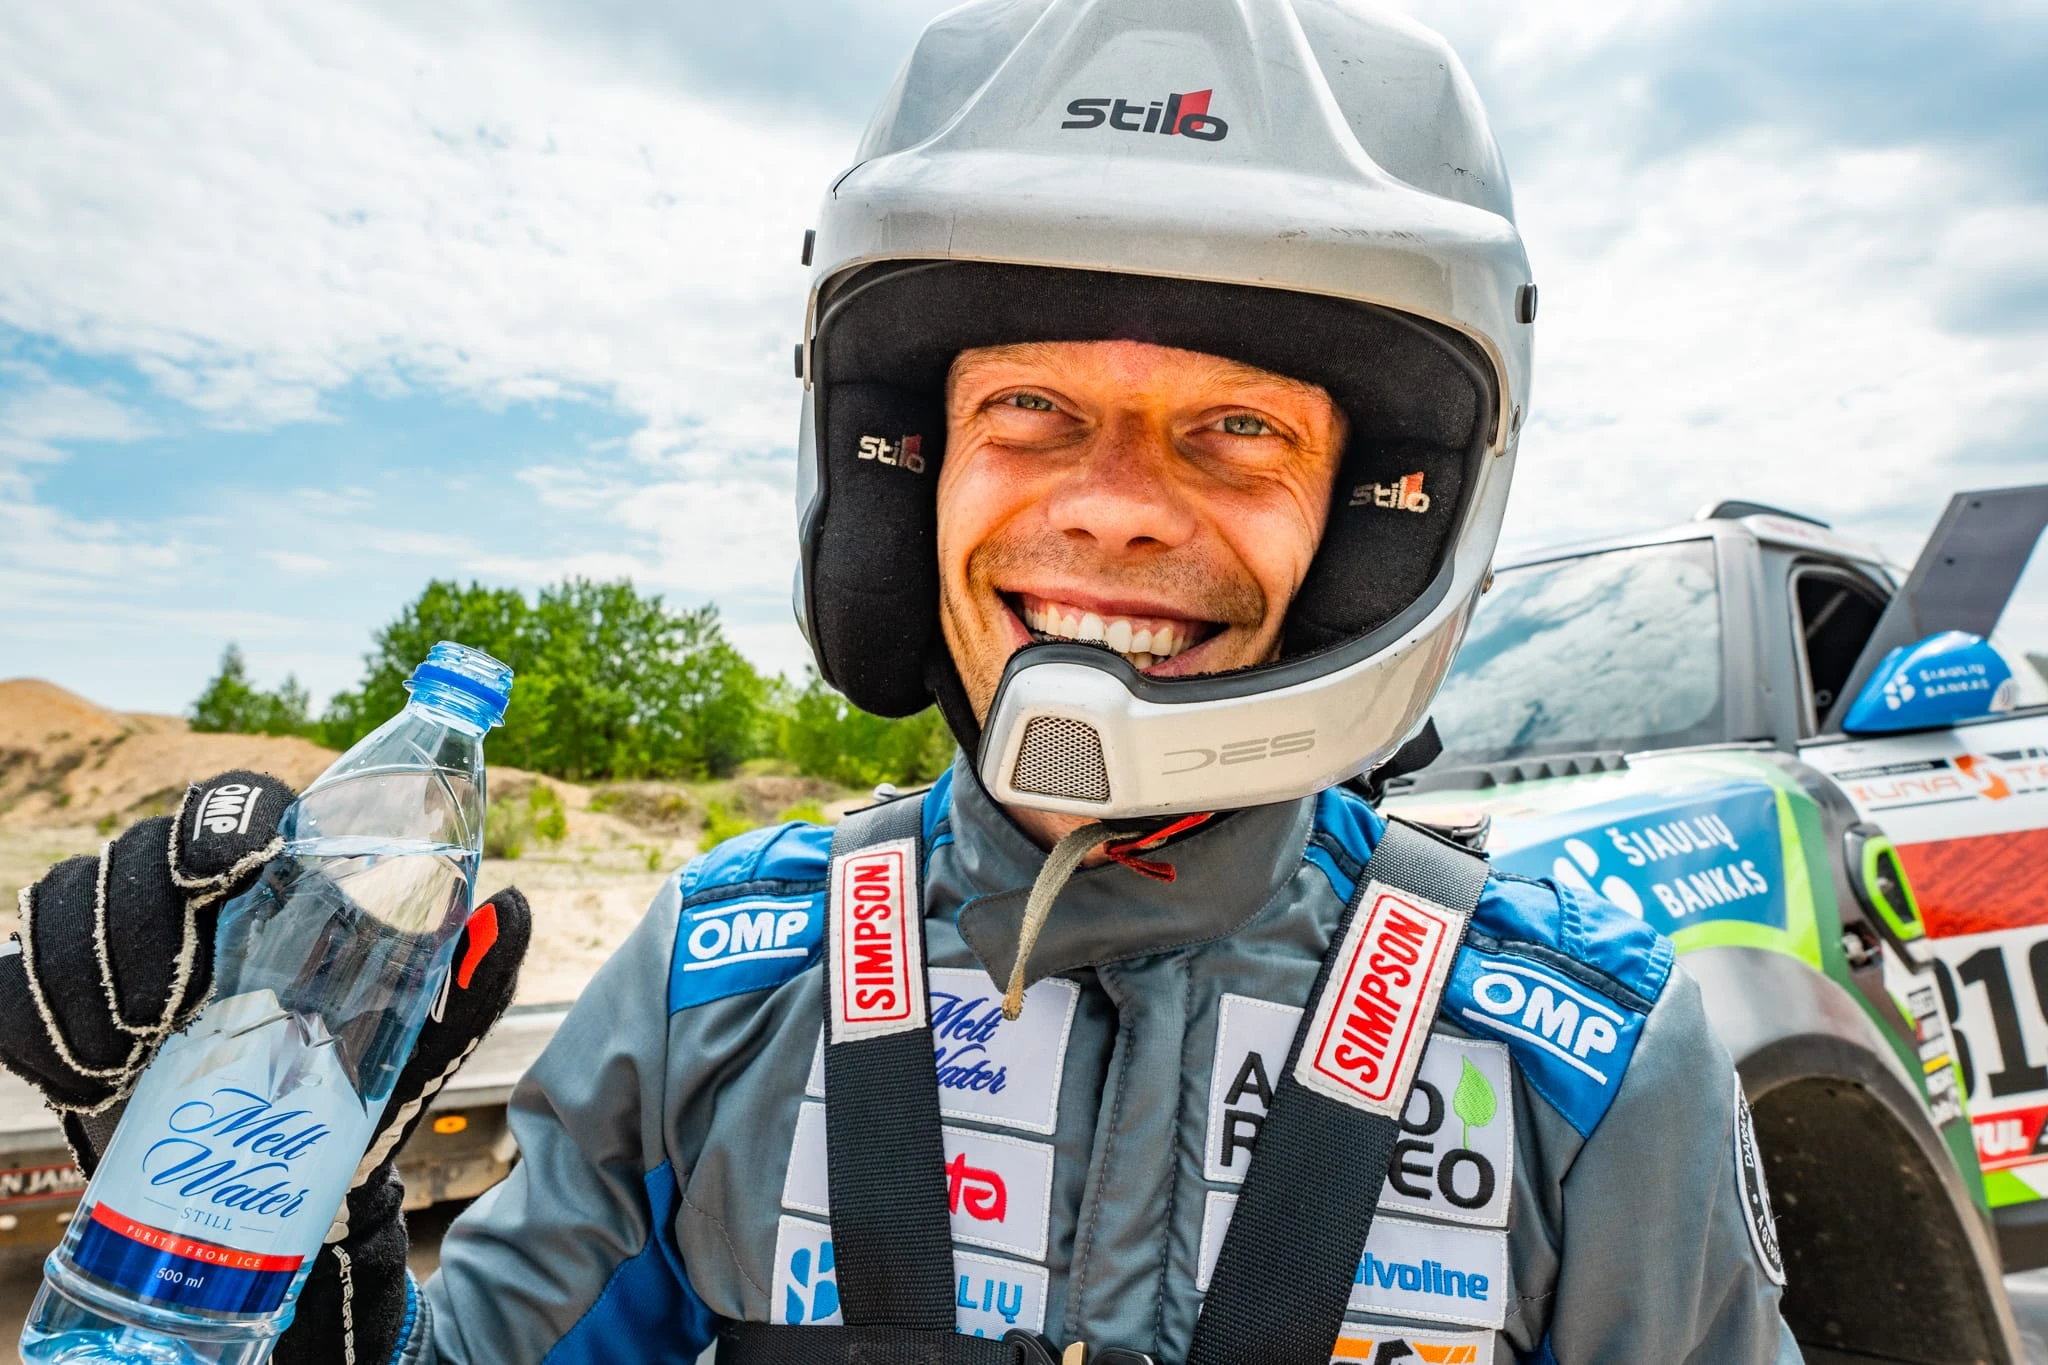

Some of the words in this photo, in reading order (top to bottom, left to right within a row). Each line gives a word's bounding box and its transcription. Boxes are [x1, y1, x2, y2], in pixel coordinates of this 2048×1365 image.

[202, 784, 251, 834] OMP
[1604, 813, 1740, 867] ŠIAULIŲ
[1651, 859, 1769, 919] BANKAS
[688, 911, 809, 960] OMP
[853, 863, 896, 1011] SIMPSON
[1334, 907, 1429, 1084] SIMPSON
[1472, 972, 1618, 1058] OMP
[169, 1087, 331, 1161] Melt
[142, 1137, 310, 1218] Water
[126, 1224, 177, 1251] PURITY
[185, 1245, 229, 1263] FROM
[237, 1256, 262, 1268] ICE
[180, 1206, 233, 1232] STILL
[156, 1267, 183, 1284] 500
[185, 1276, 204, 1289] ml
